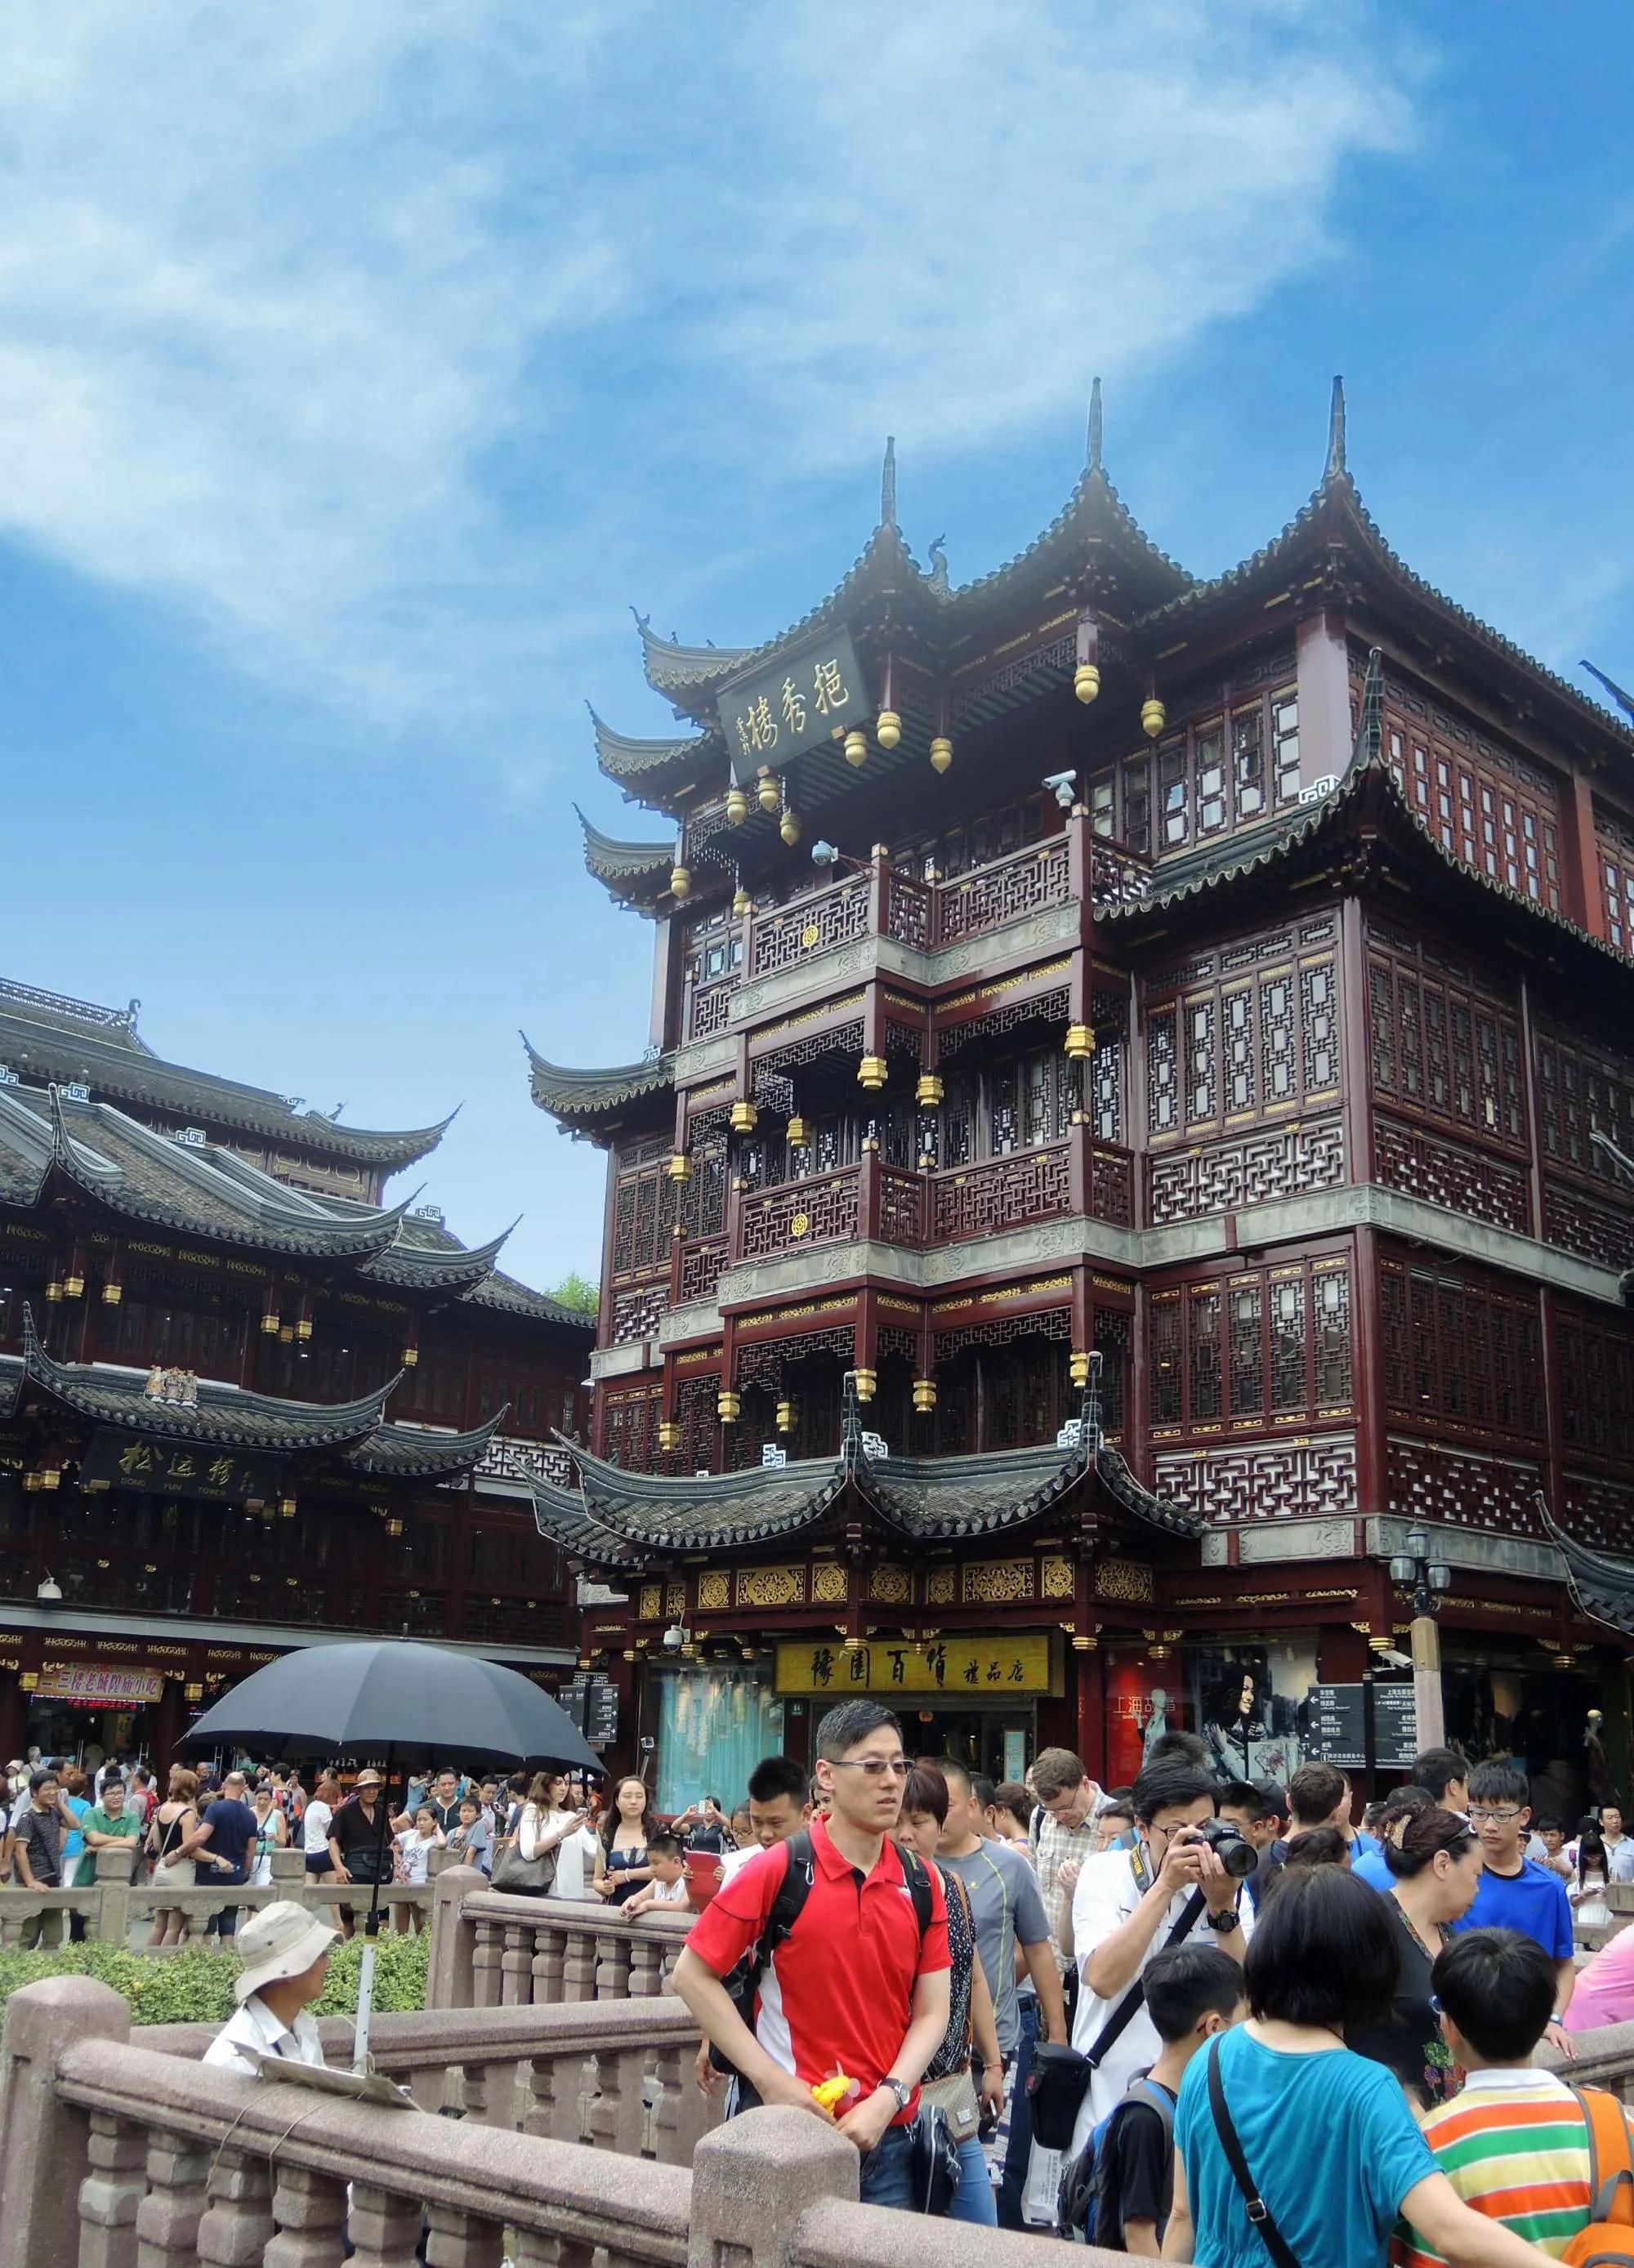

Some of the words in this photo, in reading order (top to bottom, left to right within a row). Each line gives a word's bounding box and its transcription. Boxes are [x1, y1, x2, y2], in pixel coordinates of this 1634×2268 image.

[120, 1477, 145, 1487] SONG
[164, 1483, 183, 1491] YUN
[198, 1486, 227, 1497] TOWER
